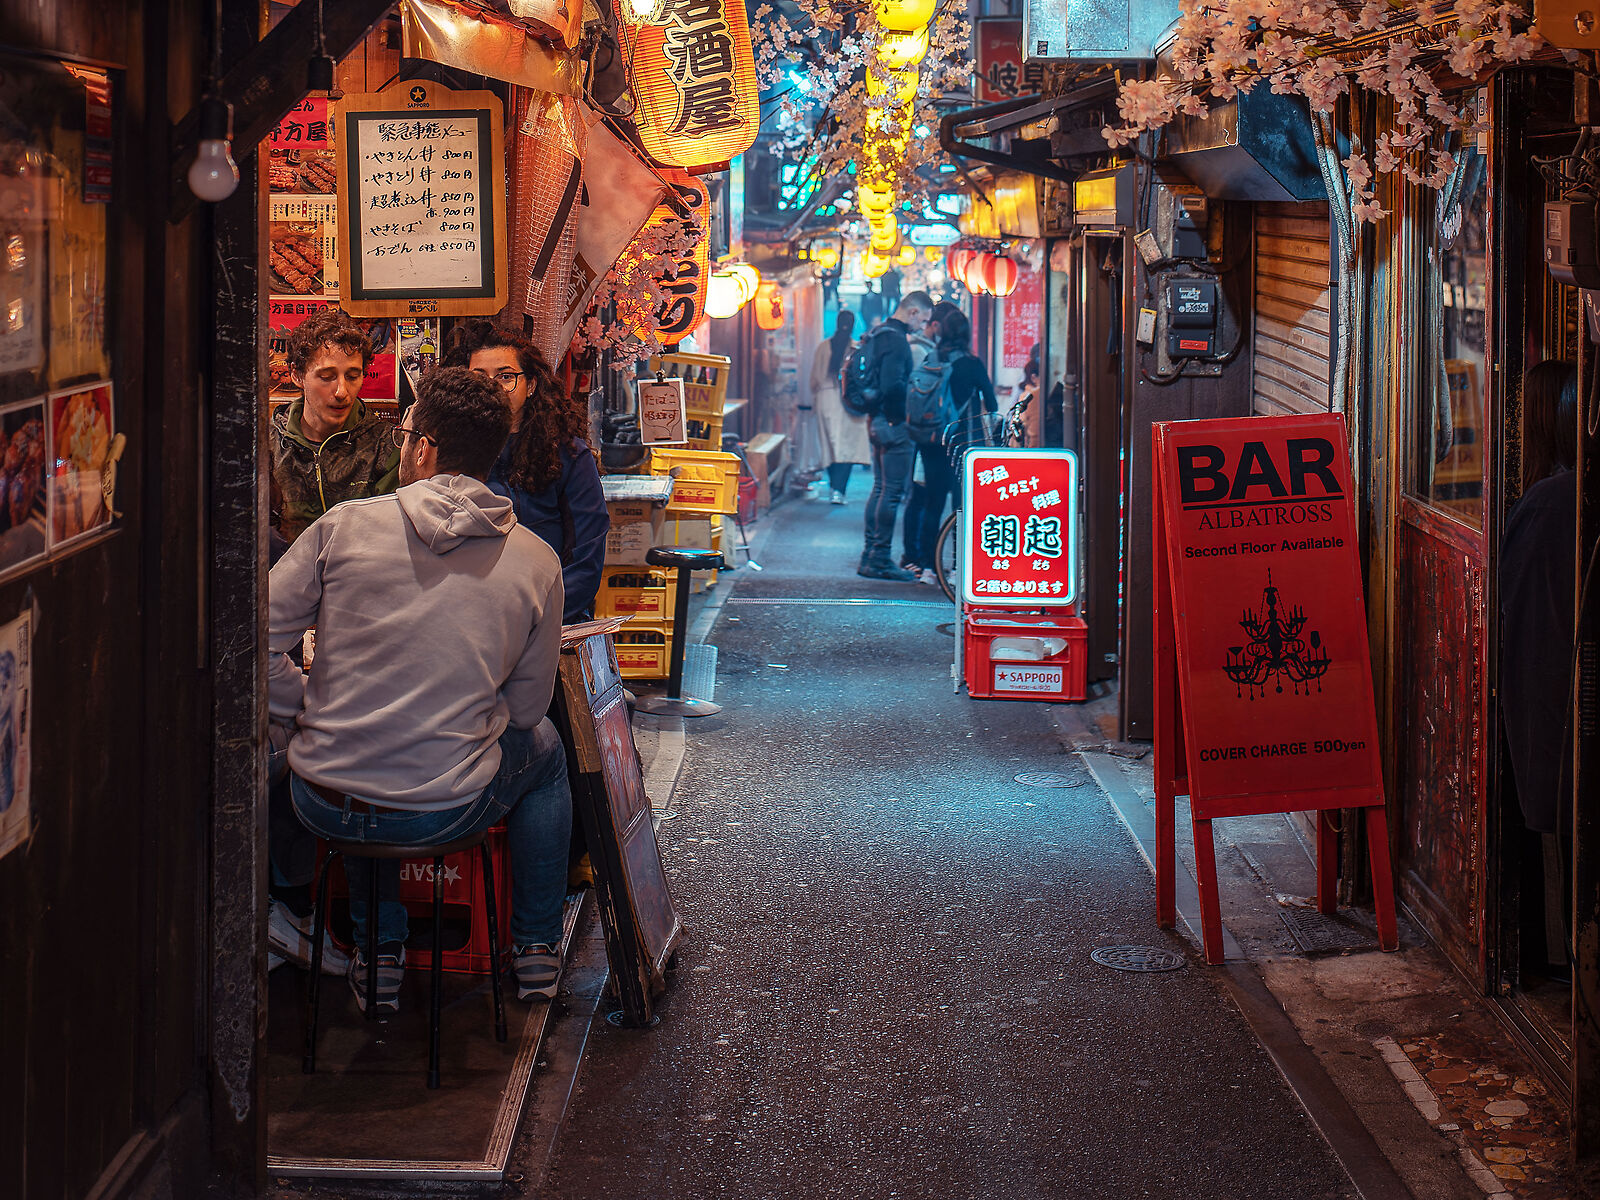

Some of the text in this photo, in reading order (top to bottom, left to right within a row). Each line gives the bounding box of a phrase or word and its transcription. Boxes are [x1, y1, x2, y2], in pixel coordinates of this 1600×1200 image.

[378, 121, 472, 142] 緊急事態メニュー
[441, 150, 473, 161] 800円
[440, 192, 474, 203] 850円
[439, 221, 474, 232] 800円
[366, 242, 413, 257] おでん
[440, 240, 476, 252] 850円
[268, 303, 328, 314] 方屋自慢の
[408, 304, 438, 313] 黒ラベル
[644, 393, 676, 406] たばこ
[977, 465, 1009, 486] 珍品
[1176, 437, 1343, 504] BAR
[997, 476, 1040, 500] スタミナ
[1031, 489, 1062, 511] 料理
[1198, 503, 1333, 531] ALBATROSS
[982, 515, 1062, 557] 朝起
[1185, 536, 1344, 559] Second Floor Available
[975, 578, 1064, 594] 2階もあります
[1010, 671, 1061, 684] SAPPORO
[1200, 739, 1366, 762] COVER CHARGE 500yen
